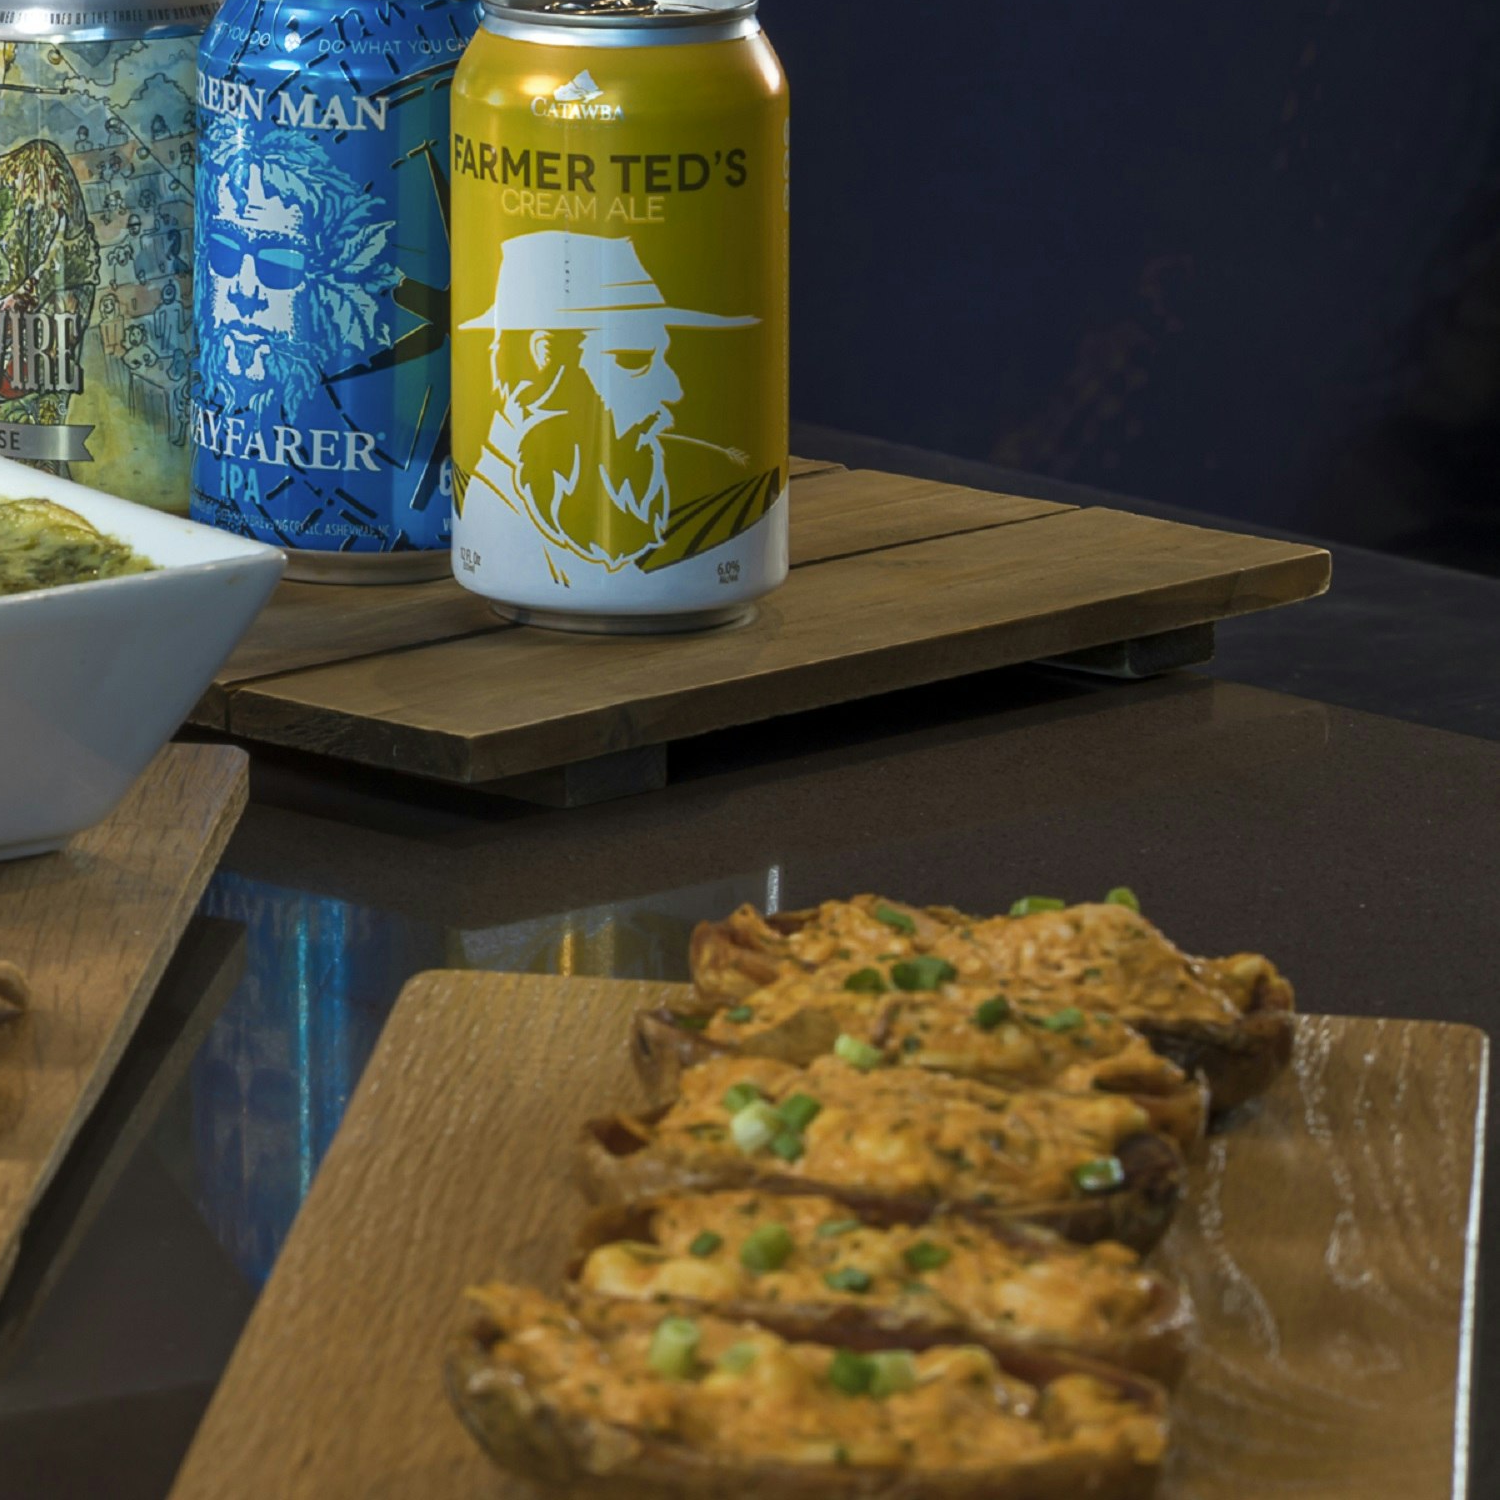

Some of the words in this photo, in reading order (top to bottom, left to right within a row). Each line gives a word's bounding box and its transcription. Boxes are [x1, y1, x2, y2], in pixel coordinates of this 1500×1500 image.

[318, 39, 345, 52] DO
[350, 40, 403, 55] WHAT
[407, 38, 442, 53] YOU
[198, 70, 265, 122] REEN
[278, 90, 390, 131] MAN
[531, 96, 626, 121] CATAWBA
[454, 133, 596, 193] FARMER
[610, 148, 748, 194] TED'S
[501, 188, 597, 221] CREAM
[604, 195, 666, 223] ALE
[190, 400, 382, 472] AYFARER
[220, 460, 261, 505] IPA
